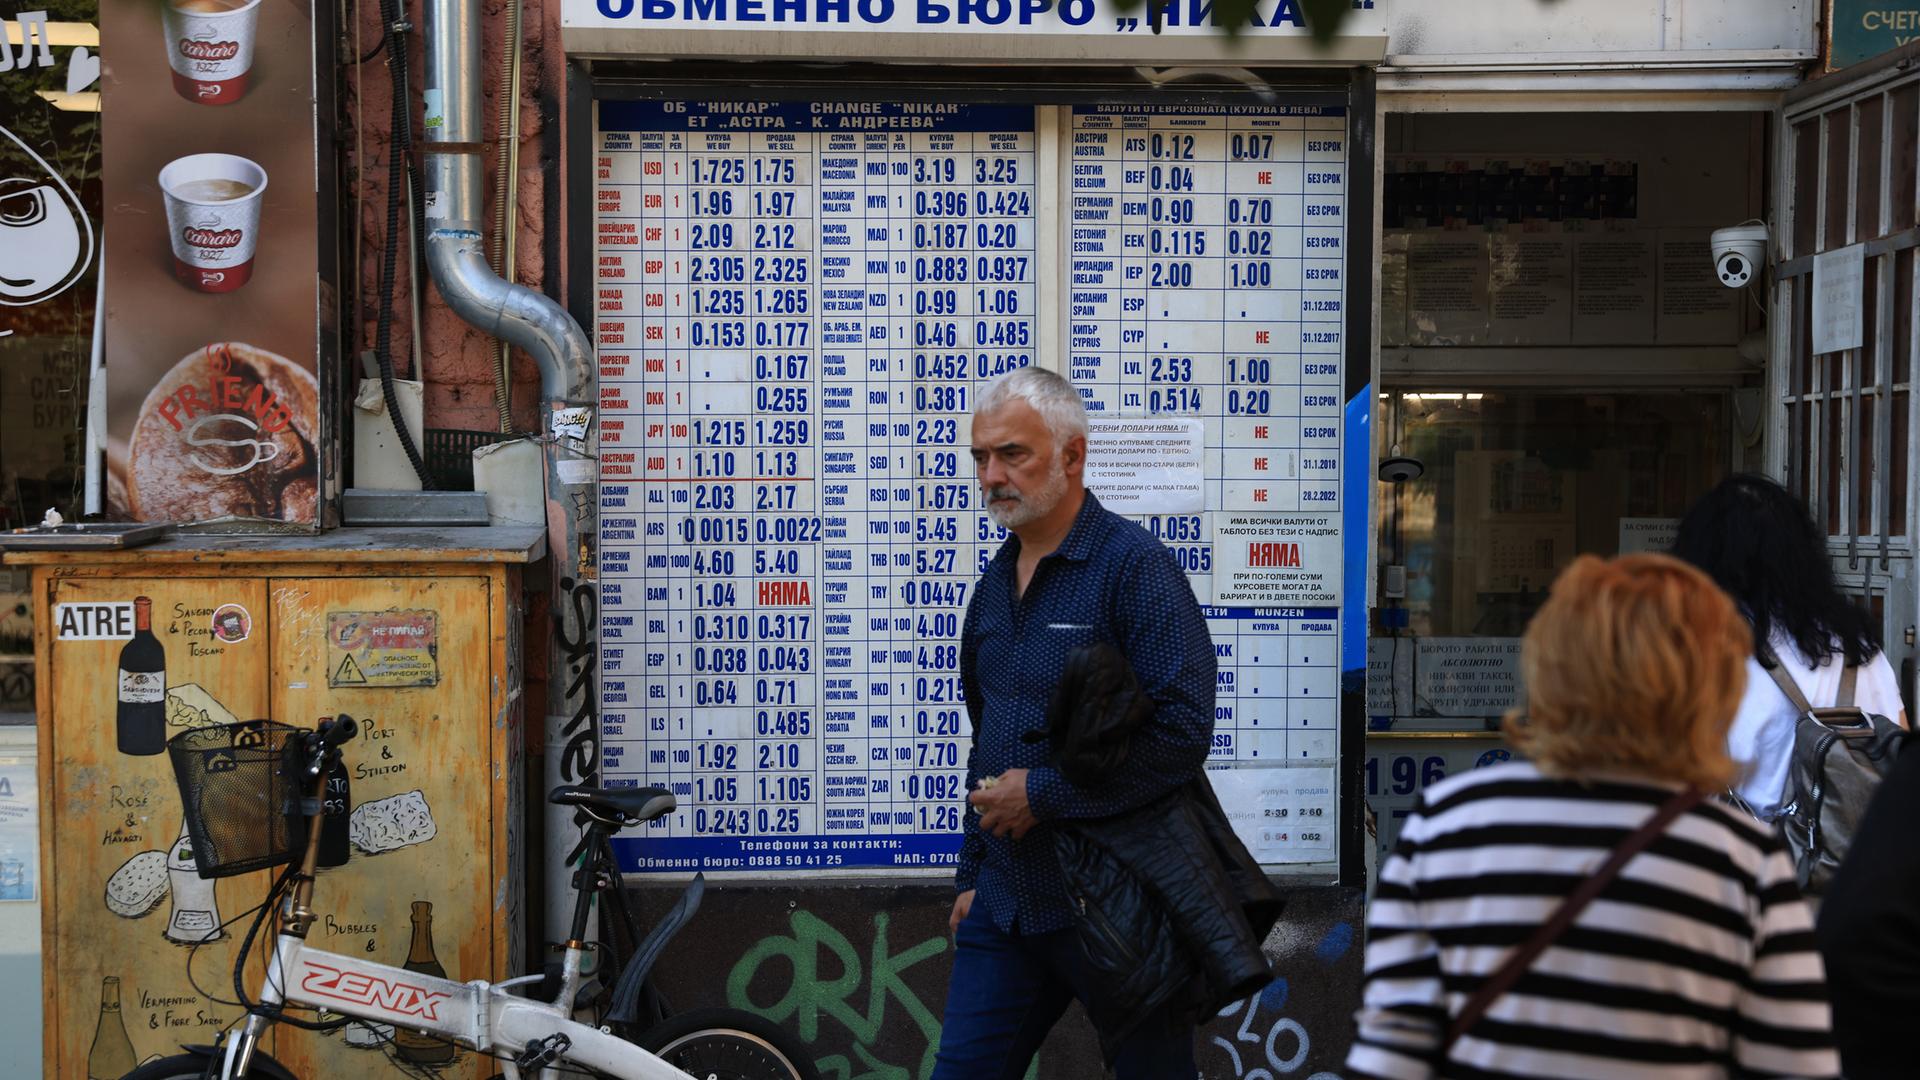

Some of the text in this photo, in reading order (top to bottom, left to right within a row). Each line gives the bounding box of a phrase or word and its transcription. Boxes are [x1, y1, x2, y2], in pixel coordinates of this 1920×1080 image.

[595, 0, 895, 24] ОБМЕННО
[1863, 11, 1920, 30] СЧЕТ
[664, 102, 686, 113] ОБ
[811, 103, 881, 113] CHANGE
[688, 116, 708, 127] ЕТ
[1075, 146, 1105, 157] AUSTRIA
[1125, 134, 1273, 159] ATS 0.12 0.07
[1308, 142, 1341, 151] БЕЗ СРОК
[644, 159, 794, 183] USD 1.725 1.75
[867, 158, 1017, 183] MKD 100 3.19 3.25
[1125, 166, 1193, 191] BEF 0.04
[1258, 172, 1272, 184] НЕ
[645, 191, 794, 216] EUR 1.96 1.97
[1123, 198, 1271, 224] DEM 0.90 0.70
[600, 268, 625, 277] ENGLAND
[645, 257, 807, 281] GBP 2.305 2.325
[823, 269, 845, 278] MEXICO
[868, 257, 1028, 283] MXN 0.883 0.937
[600, 302, 623, 310] CANADA
[646, 290, 807, 314] CAD 1.235 1.265
[869, 290, 1017, 314] NZD 0.99 1.06
[1123, 330, 1144, 343] CYP
[1256, 332, 1269, 344] НЕ
[1303, 333, 1339, 343] 31.12.2017
[870, 355, 967, 379] PLN 0.452
[1124, 358, 1269, 383] LVL 2.53 1.00
[601, 433, 620, 442] JAPAN
[647, 421, 808, 445] JPY 100 1.215 1.259
[647, 452, 797, 476] AUD 1.10 1.13
[649, 485, 796, 510] ALL 2.03 2.17
[870, 517, 956, 541] TWD 5.45
[647, 550, 798, 575] AMD 4.60 5.40
[1250, 543, 1300, 566] НЯМА
[647, 583, 735, 607] BAM 1.04
[759, 582, 810, 606] НЯМА
[60, 606, 131, 636] ATRE
[649, 615, 809, 639] BRL 0.310 0.317
[871, 614, 956, 637] UAH 4.00
[381, 745, 393, 759] &
[604, 759, 619, 767] INDIA
[651, 744, 799, 769] INR 100 1.92 2.10
[696, 809, 799, 833] 0.243 0.25
[827, 821, 864, 829] SOUTH KOREA
[871, 806, 958, 830] KRW 1.26
[741, 840, 902, 851] Телефони за контакти:
[638, 855, 842, 869] Обменно бюро: 0888 50 41 25
[894, 854, 925, 864] НАП:
[366, 939, 375, 952] &
